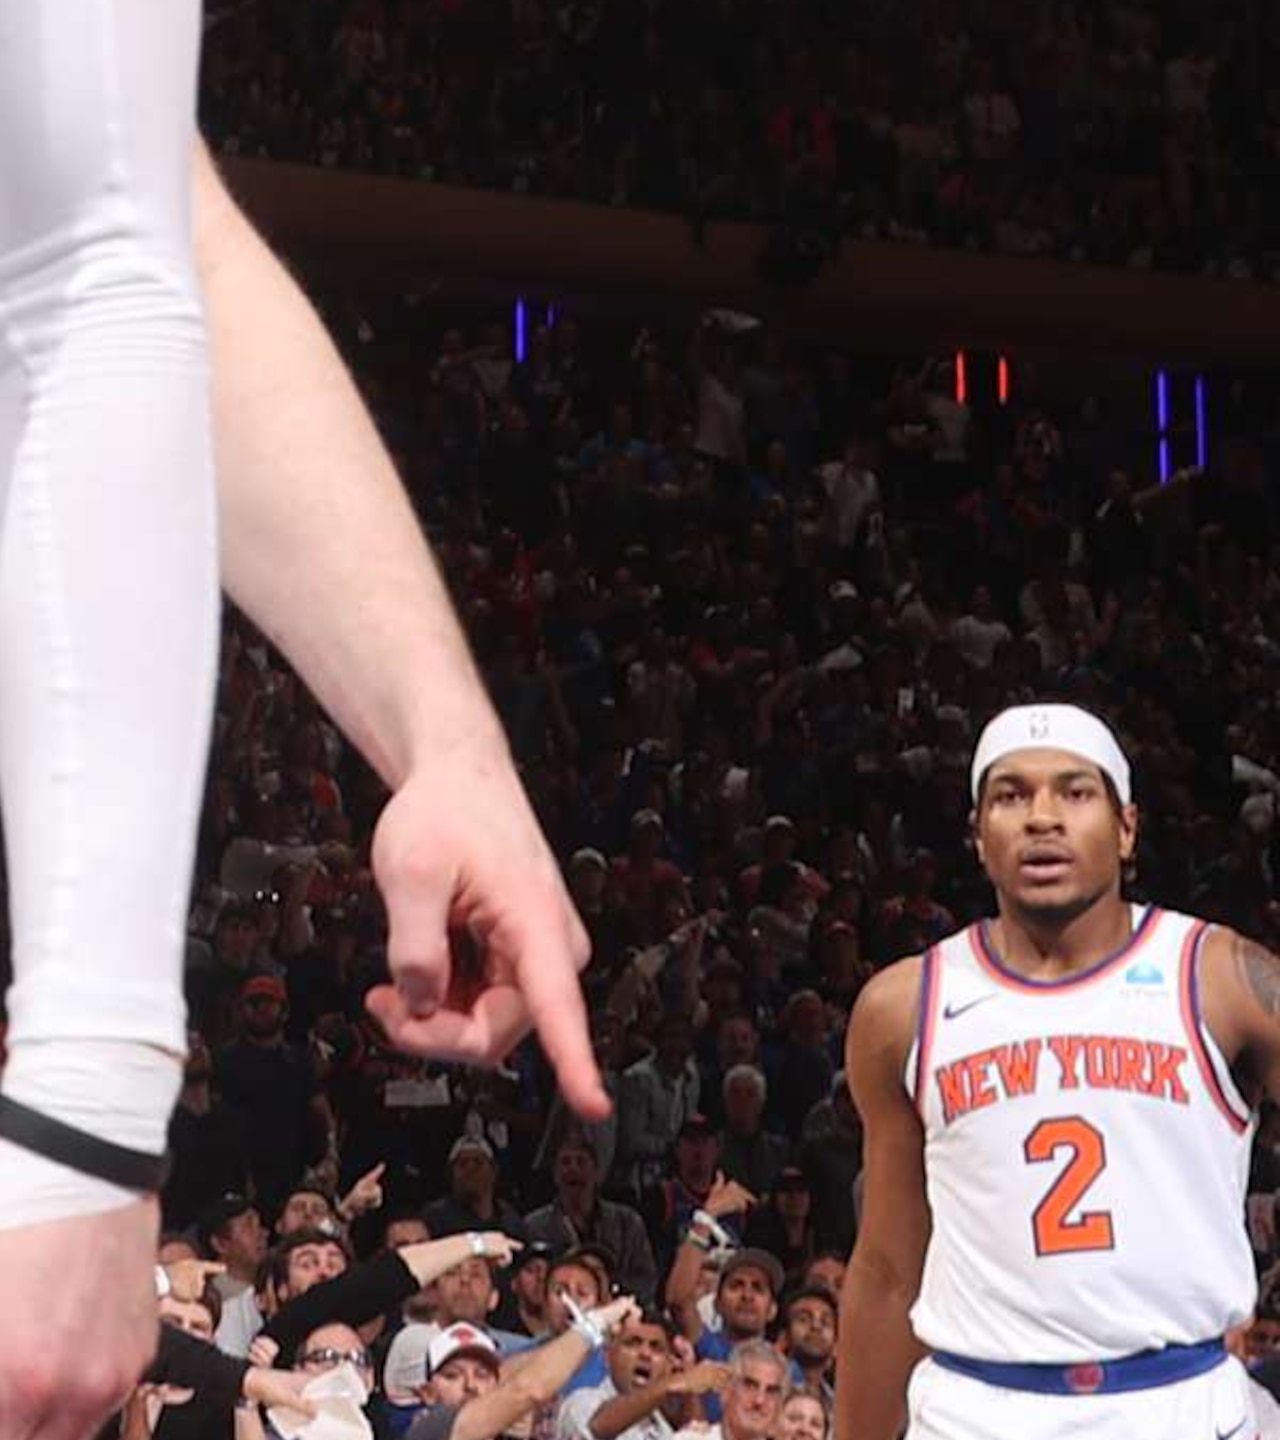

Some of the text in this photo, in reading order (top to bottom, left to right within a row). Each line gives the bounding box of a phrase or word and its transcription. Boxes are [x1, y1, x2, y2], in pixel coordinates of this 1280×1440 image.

[935, 1034, 1190, 1124] NEW YORK
[1024, 1115, 1115, 1257] 2
